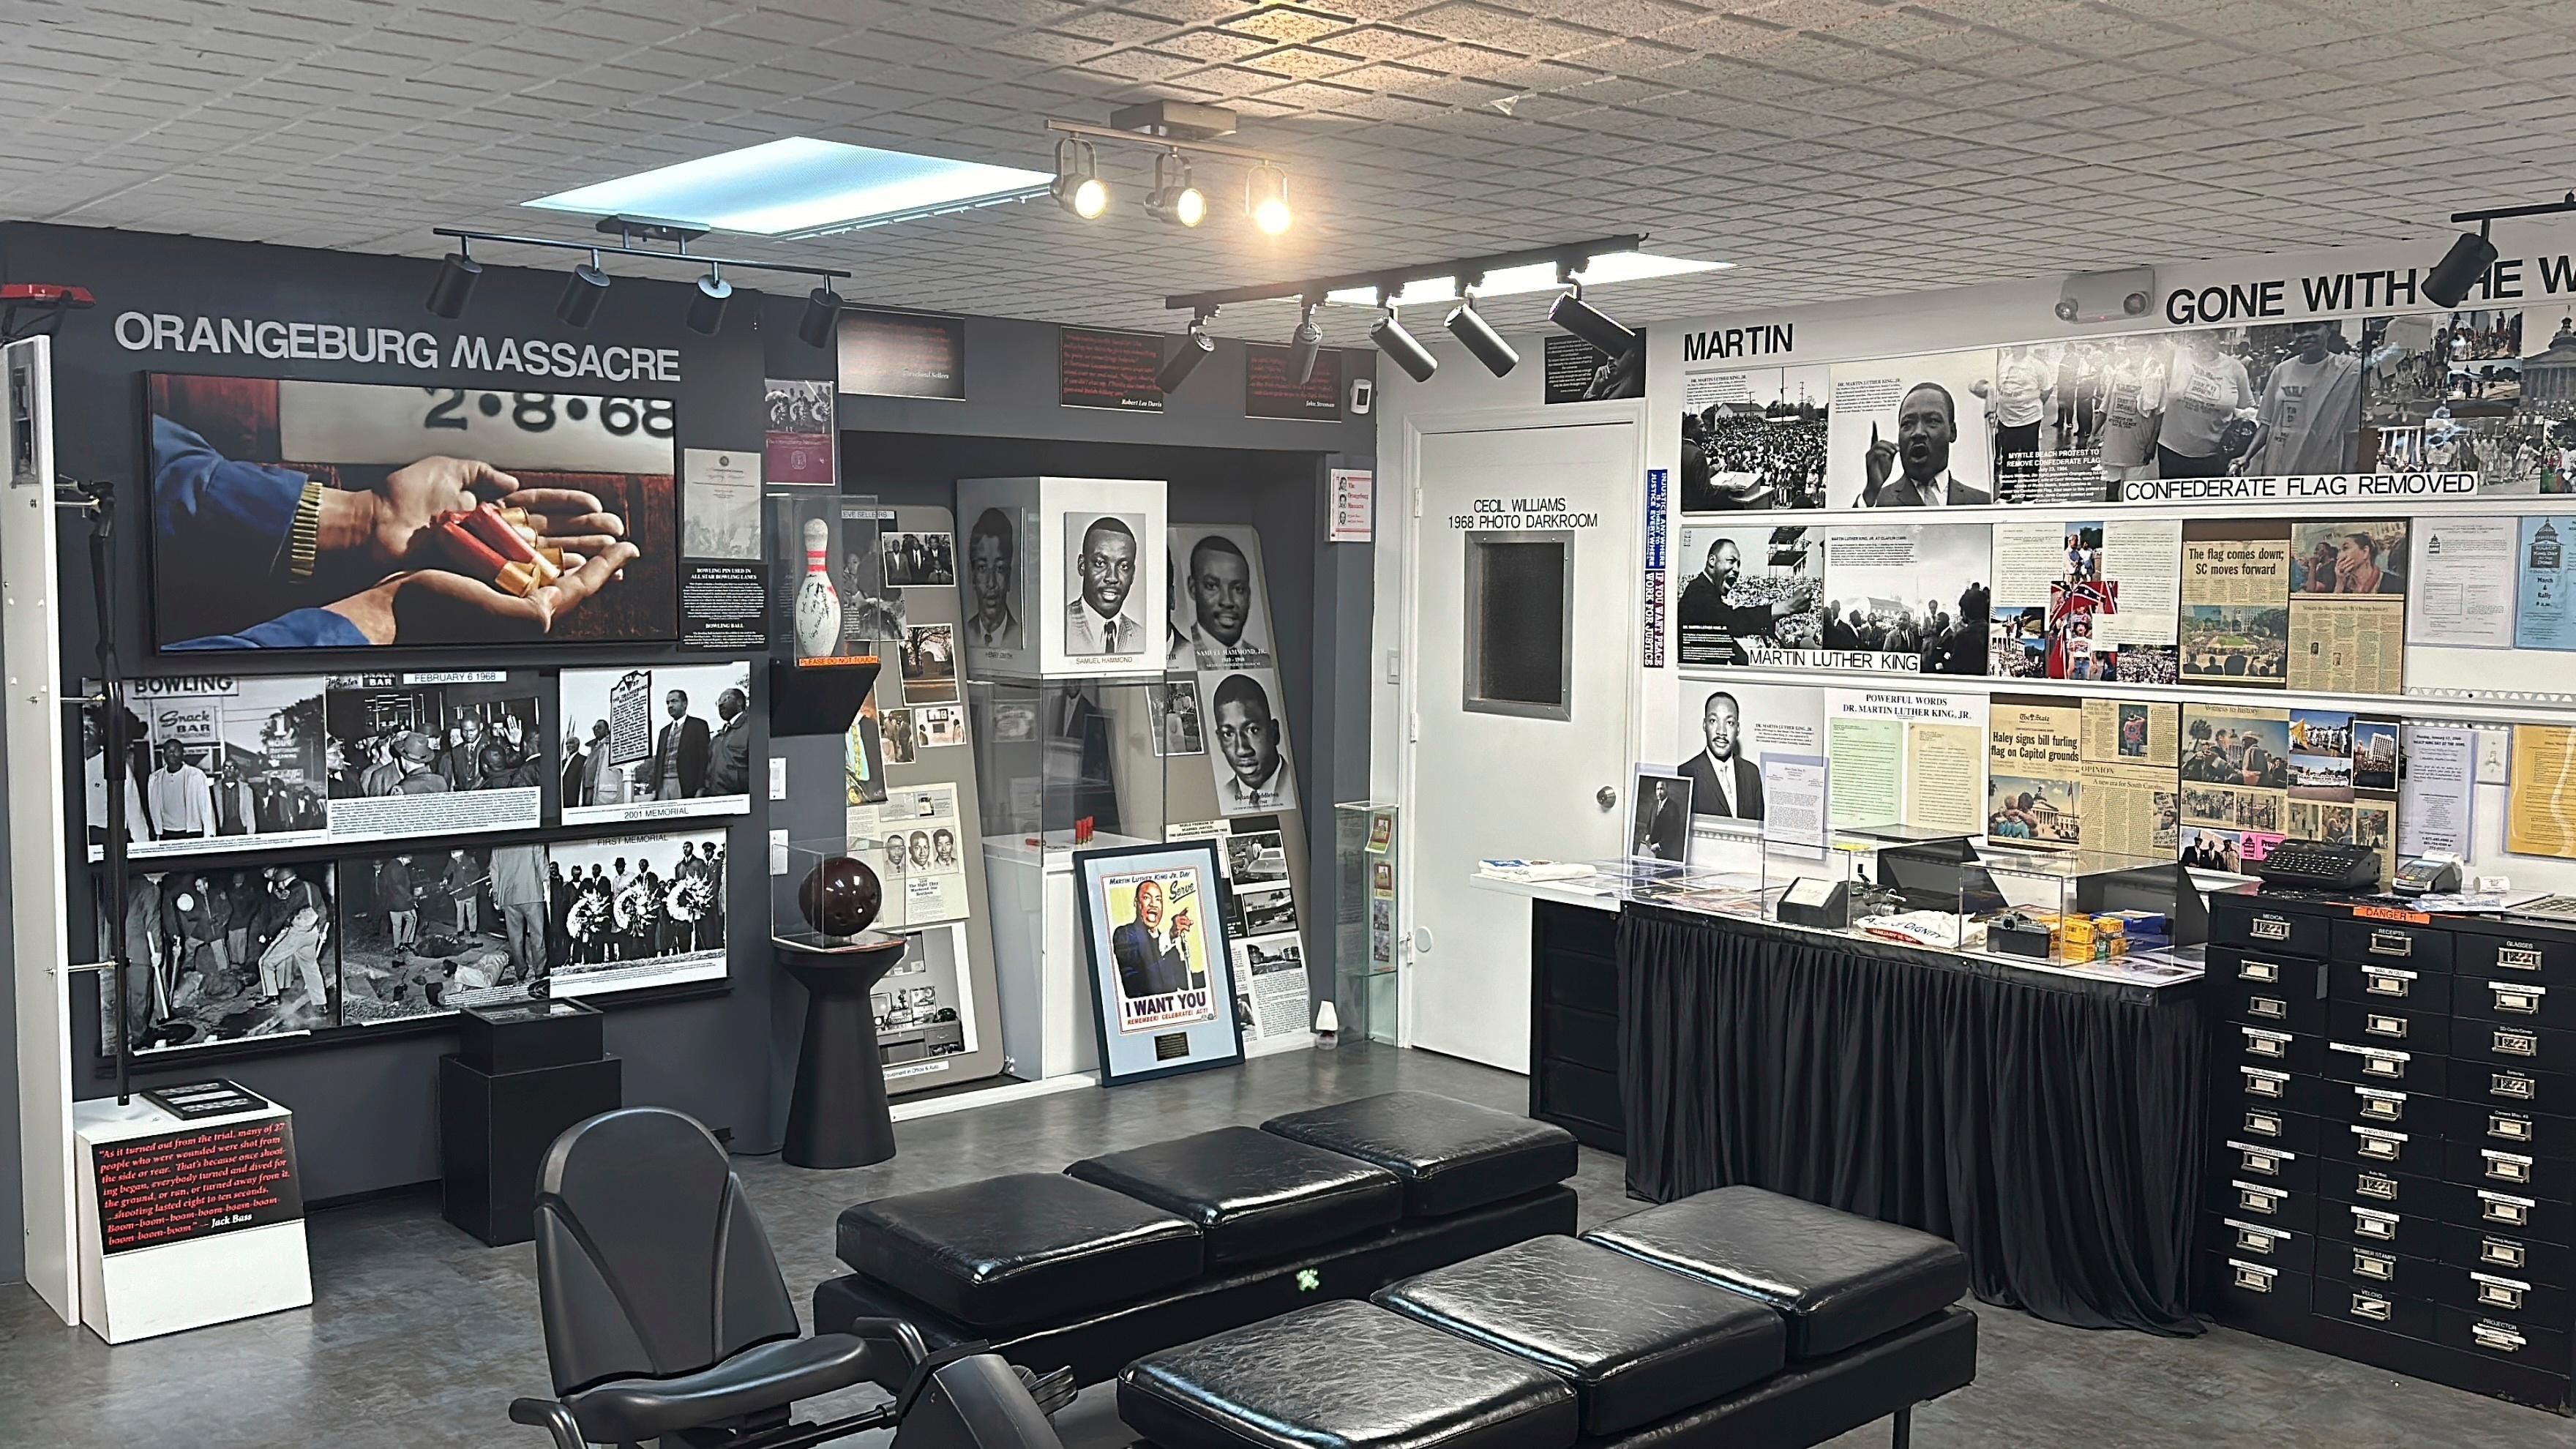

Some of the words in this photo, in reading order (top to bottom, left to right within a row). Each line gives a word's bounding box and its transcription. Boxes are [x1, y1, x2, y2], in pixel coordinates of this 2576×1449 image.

[2166, 281, 2284, 324] GONE
[2302, 269, 2416, 312] WITH
[2430, 260, 2523, 302] HE
[115, 311, 437, 368] ORANGEBURG
[450, 334, 681, 382] MASSACRE
[1684, 323, 1793, 362] MARTIN
[2034, 457, 2081, 466] CONFEDERATE
[2126, 478, 2276, 501] CONFEDERATE
[2287, 477, 2347, 495] FLAG
[2359, 473, 2474, 494] REMOVED
[1474, 498, 1504, 513] CECIL
[1512, 498, 1566, 512] WILLIAMS
[1448, 515, 1474, 528] 1968
[1480, 514, 1520, 528] PHOTO
[1527, 513, 1598, 528] DARKROOM
[2189, 548, 2204, 560] The
[2207, 548, 2223, 563] flag
[2227, 550, 2255, 561] comes
[2258, 549, 2284, 563] down;
[2195, 563, 2208, 575] SC
[2210, 566, 2239, 576] moves
[2241, 562, 2276, 576] forward
[1655, 572, 1664, 583] IF
[1645, 572, 1655, 604] WORK
[1655, 585, 1664, 604] YOU
[1645, 604, 1654, 624] FOR
[1655, 605, 1663, 633] WANT
[1644, 625, 1654, 666] JUSTICE
[1654, 634, 1663, 666] PEACE
[839, 657, 853, 665] NOT
[1076, 656, 1101, 665] SAMUEL
[1101, 656, 1133, 664] HAMMOND
[1750, 650, 1805, 667] MARTIN
[1813, 651, 1872, 669] LUTHER
[1882, 654, 1918, 672] KING
[369, 678, 392, 686] BAR
[414, 673, 465, 682] FEBRUARY
[476, 672, 496, 681] 1968
[135, 677, 233, 694] BOWLING
[1865, 693, 1913, 705] POWERFUL
[1916, 695, 1947, 706] WORDS
[1843, 703, 1857, 714] DR.
[1859, 704, 1892, 716] MARTIN
[1894, 705, 1930, 717] LUTHER
[1958, 708, 1972, 719] JR.
[2204, 705, 2228, 714] Witness
[2230, 706, 2237, 714] to
[2240, 706, 2259, 716] history
[159, 710, 210, 727] Snack
[176, 724, 211, 733] BAR
[1993, 731, 2013, 744] Haley
[2015, 734, 2035, 746] signs
[2037, 733, 2049, 745] bill
[2053, 735, 2078, 750] furling
[1991, 746, 2005, 758] flag
[2008, 749, 2017, 757] on
[2019, 747, 2045, 760] Capitol
[2048, 751, 2079, 762] grounds
[2081, 765, 2114, 774] OPINION
[624, 811, 643, 819] 2001
[645, 807, 689, 817] MEMORIAL
[597, 836, 621, 846] FIRST
[624, 834, 668, 844] MEMORIAL
[1109, 877, 1130, 885] MARTIN
[1169, 880, 1195, 900] Serve
[2263, 913, 2284, 921] MEDICAL
[2366, 907, 2407, 921] DANGER
[1903, 922, 1944, 939] DIGNITY
[2378, 928, 2405, 936] RECEIPTS
[2506, 940, 2533, 949] GLASSES
[1125, 1001, 1131, 1017] I
[1134, 996, 1174, 1016] WANT
[1177, 991, 1206, 1009] YOU
[1127, 1015, 1159, 1025] REMEMBER!
[1161, 1011, 1194, 1021] CELEBRATE!
[116, 1148, 123, 1156] it
[126, 1142, 156, 1155] turned
[157, 1140, 173, 1150] out
[174, 1137, 196, 1150] from
[198, 1134, 211, 1143] the
[238, 1128, 262, 1137] many
[263, 1123, 274, 1134] of
[100, 1159, 130, 1174] people
[132, 1157, 151, 1165] who
[153, 1153, 173, 1161] were
[176, 1145, 216, 1158] wounded
[217, 1142, 239, 1152] were
[240, 1139, 258, 1148] shot
[259, 1136, 281, 1147] from
[102, 1172, 116, 1184] the
[118, 1170, 136, 1181] side
[150, 1167, 171, 1176] rear.
[176, 1160, 201, 1172] That's
[203, 1156, 236, 1167] because
[239, 1151, 259, 1161] once
[260, 1147, 287, 1158] shoot-
[103, 1187, 118, 1197] ing
[119, 1182, 149, 1194] began,
[151, 1174, 198, 1188] everybody
[199, 1168, 228, 1180] turned
[230, 1164, 247, 1174] and
[249, 1160, 273, 1171] dived
[274, 1158, 287, 1169] for
[105, 1199, 119, 1208] the
[158, 1191, 168, 1199] or
[203, 1180, 232, 1191] turned
[233, 1175, 257, 1186] away
[259, 1173, 280, 1186] from
[282, 1169, 291, 1178] it.
[155, 1200, 181, 1212] lasted
[183, 1196, 206, 1209] eight
[207, 1195, 216, 1203] to
[217, 1193, 232, 1202] ten
[211, 1216, 231, 1228] Jack
[232, 1213, 252, 1224] Bass
[2353, 1247, 2375, 1257] RUBBER
[2375, 1251, 2397, 1262] STAMPS
[2361, 1288, 2383, 1299] VELCRO
[2483, 1318, 2517, 1330] PROJECTOR
